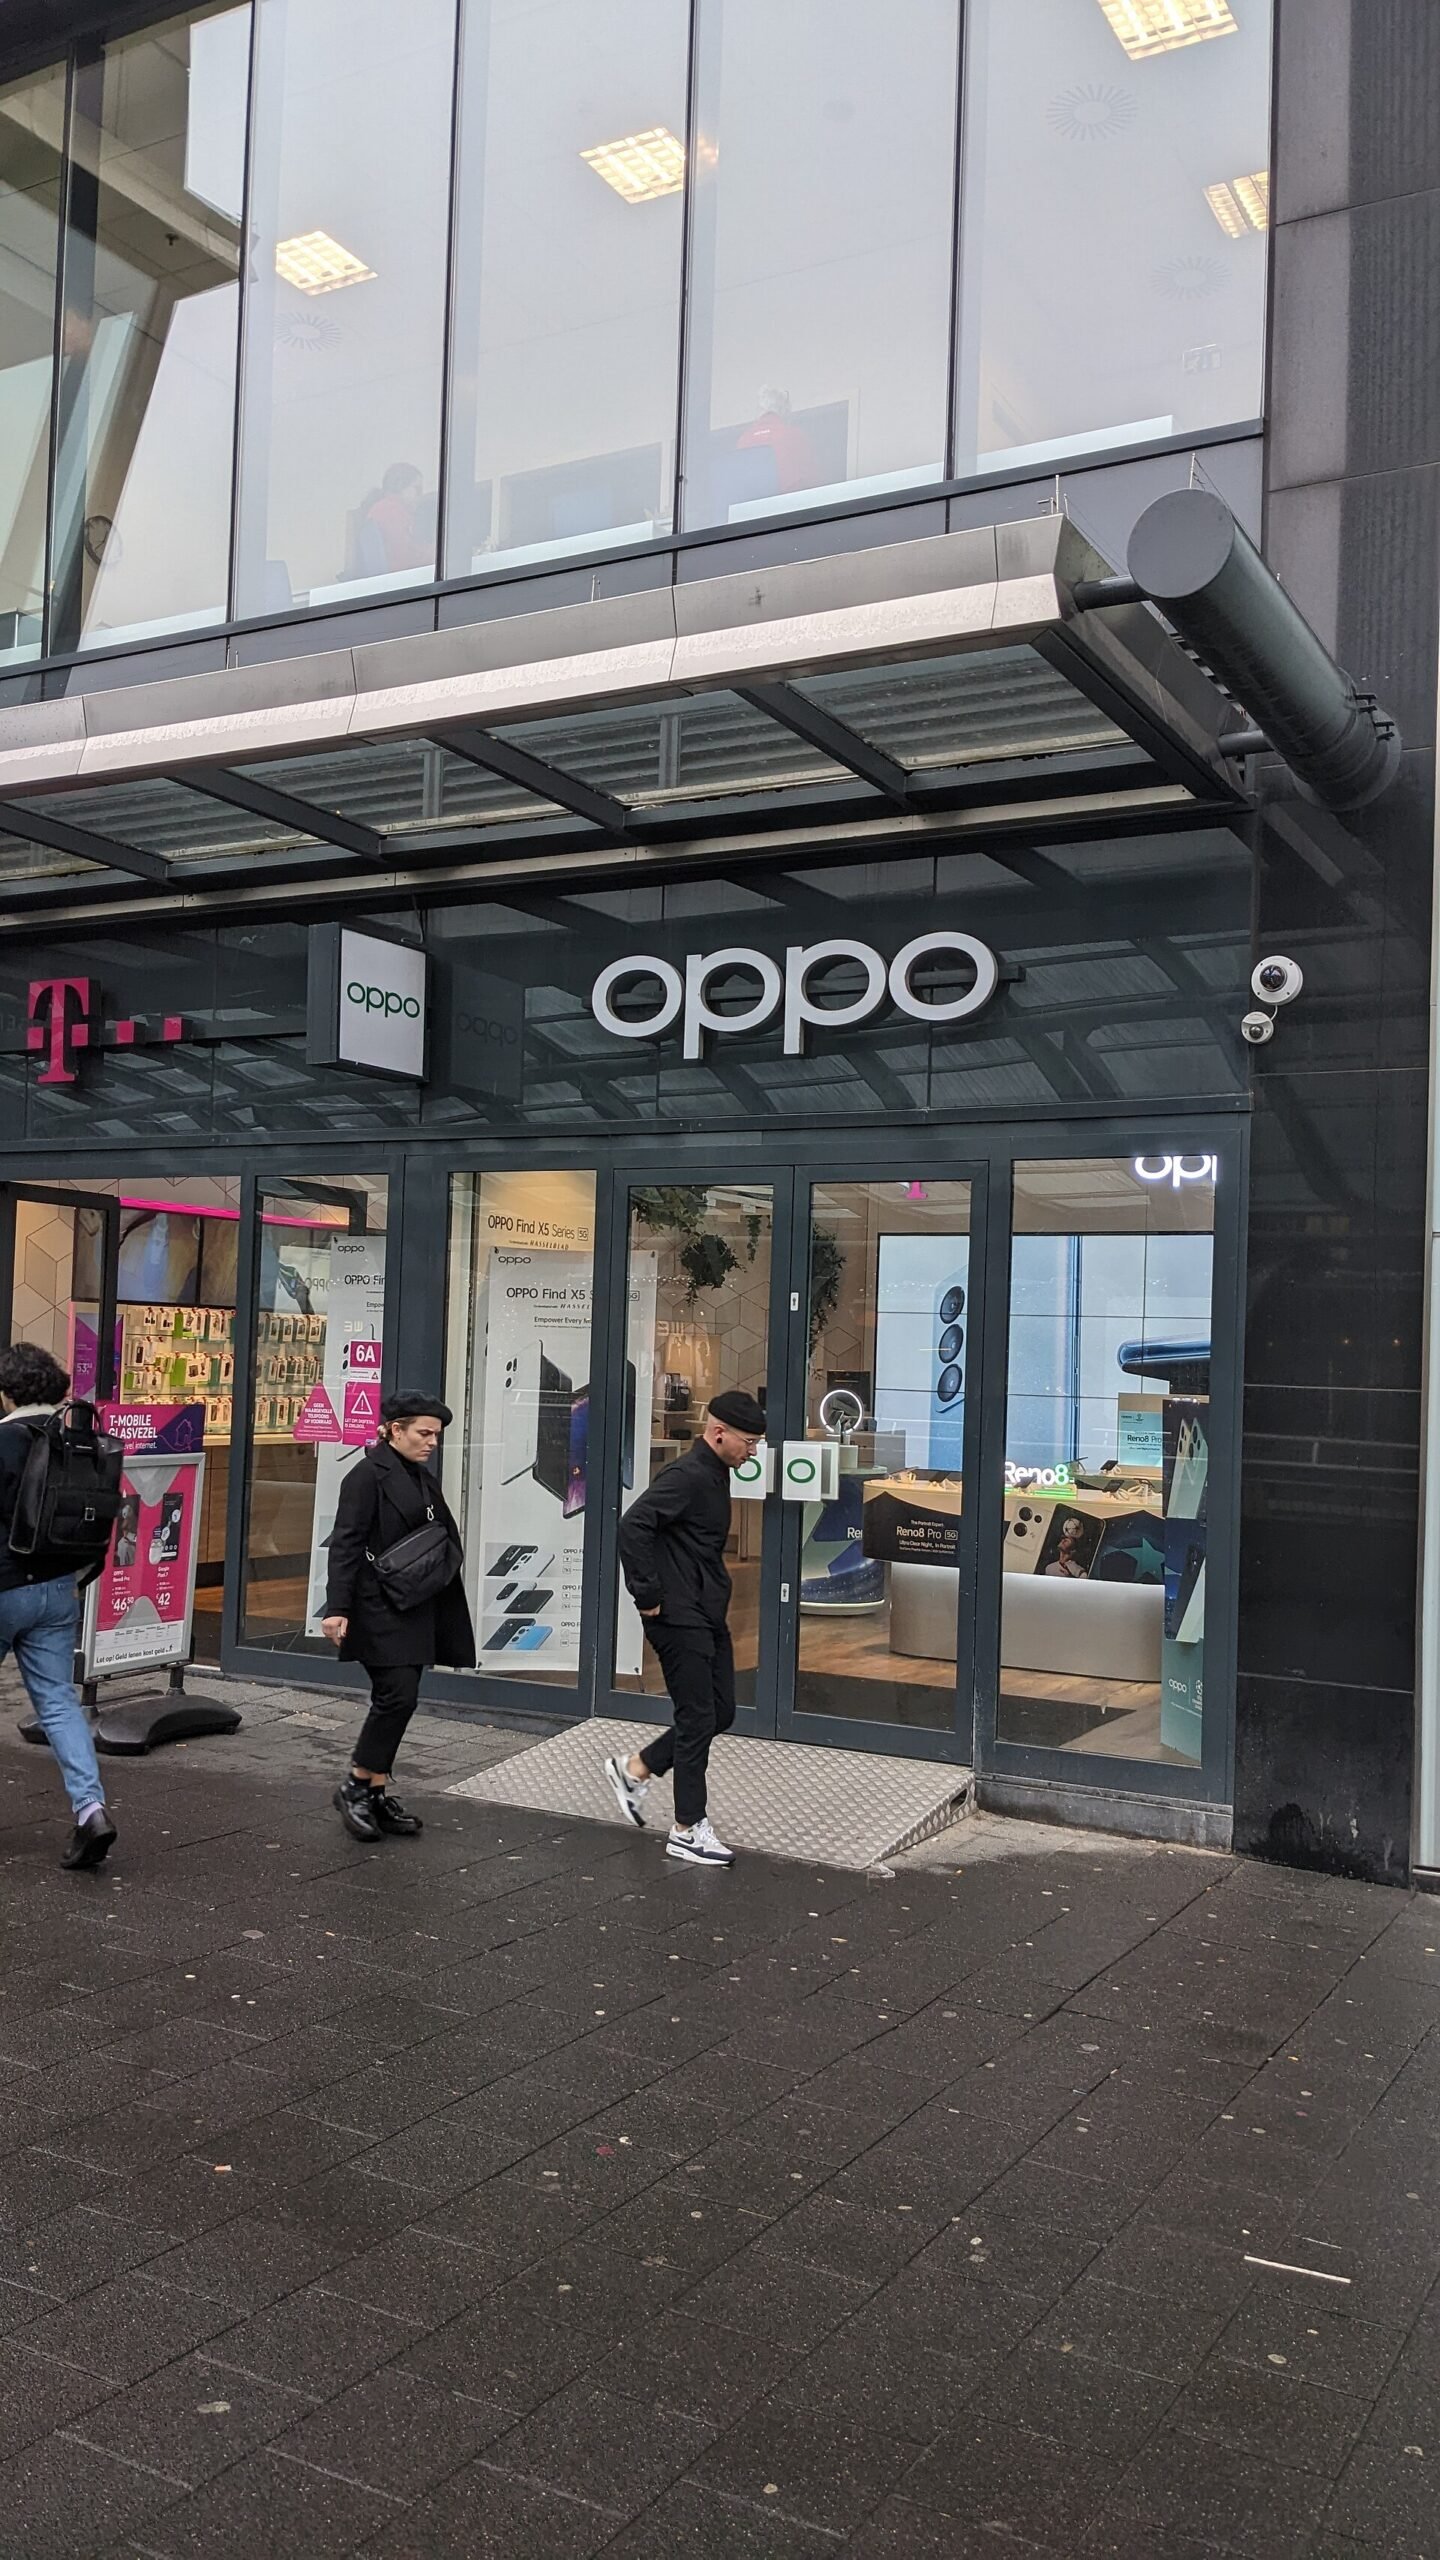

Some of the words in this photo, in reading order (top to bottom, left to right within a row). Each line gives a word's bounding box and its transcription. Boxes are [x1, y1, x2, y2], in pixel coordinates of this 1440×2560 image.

[346, 981, 421, 1018] oppo
[592, 931, 996, 1060] oppo
[488, 1215, 513, 1231] OPPO
[516, 1219, 535, 1234] Find
[538, 1222, 549, 1236] X5
[552, 1223, 575, 1239] Series
[579, 1230, 588, 1238] 5G
[337, 1245, 365, 1253] oppo
[498, 1256, 531, 1266] oppo
[344, 1275, 370, 1285] OPPO
[506, 1287, 538, 1298] OPPO
[542, 1288, 566, 1299] Find
[570, 1289, 585, 1299] X5
[534, 1316, 563, 1324] Empower
[355, 1345, 375, 1363] 6A
[109, 1414, 152, 1427] T-MOBILE
[108, 1427, 158, 1439] GLASVEZEL
[1127, 1434, 1149, 1442] Reno8
[1004, 1461, 1069, 1486] Reno8
[896, 1526, 925, 1538] Reno8
[927, 1528, 942, 1539] Pro
